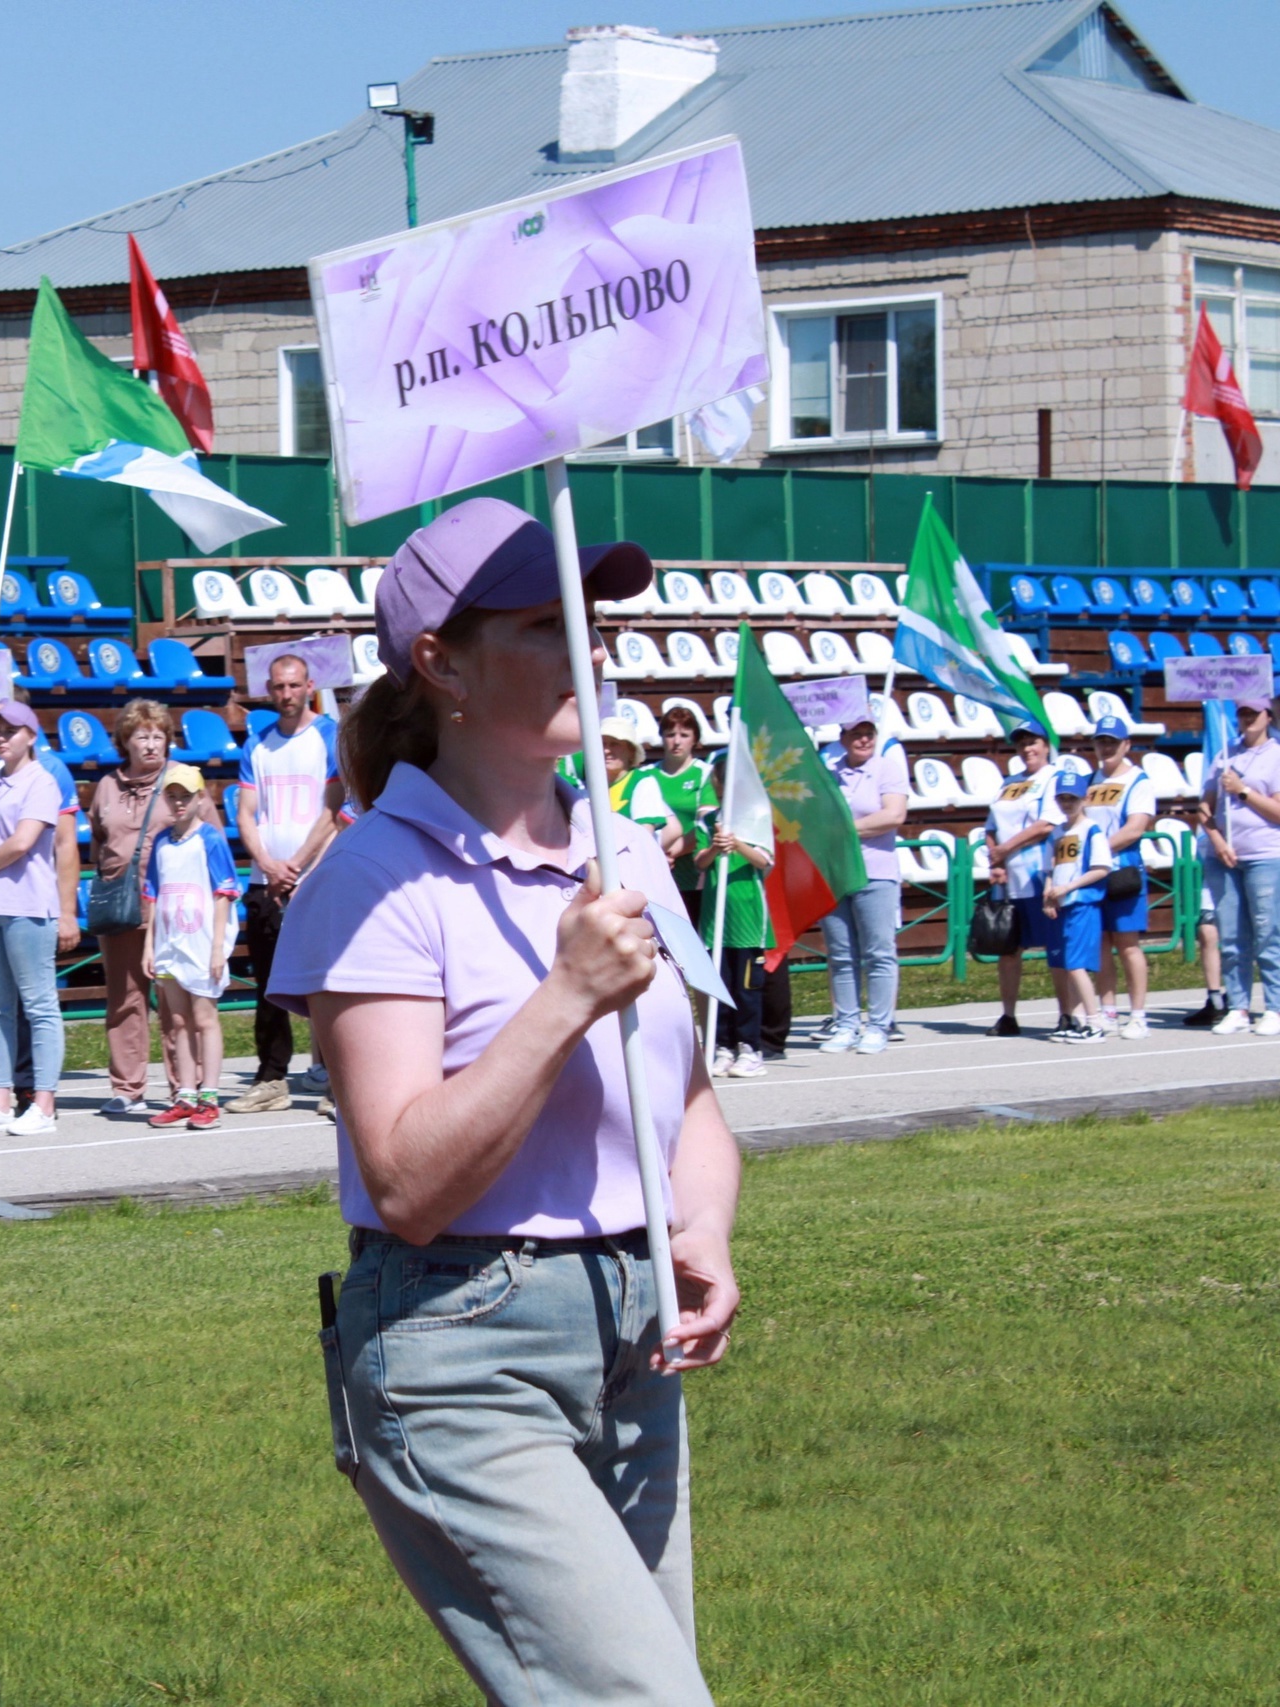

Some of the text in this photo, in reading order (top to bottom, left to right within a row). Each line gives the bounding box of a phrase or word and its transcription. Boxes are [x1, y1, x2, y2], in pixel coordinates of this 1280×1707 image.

[394, 259, 691, 408] р.п. КОЛЬЦОВО
[1089, 789, 1120, 802] 117
